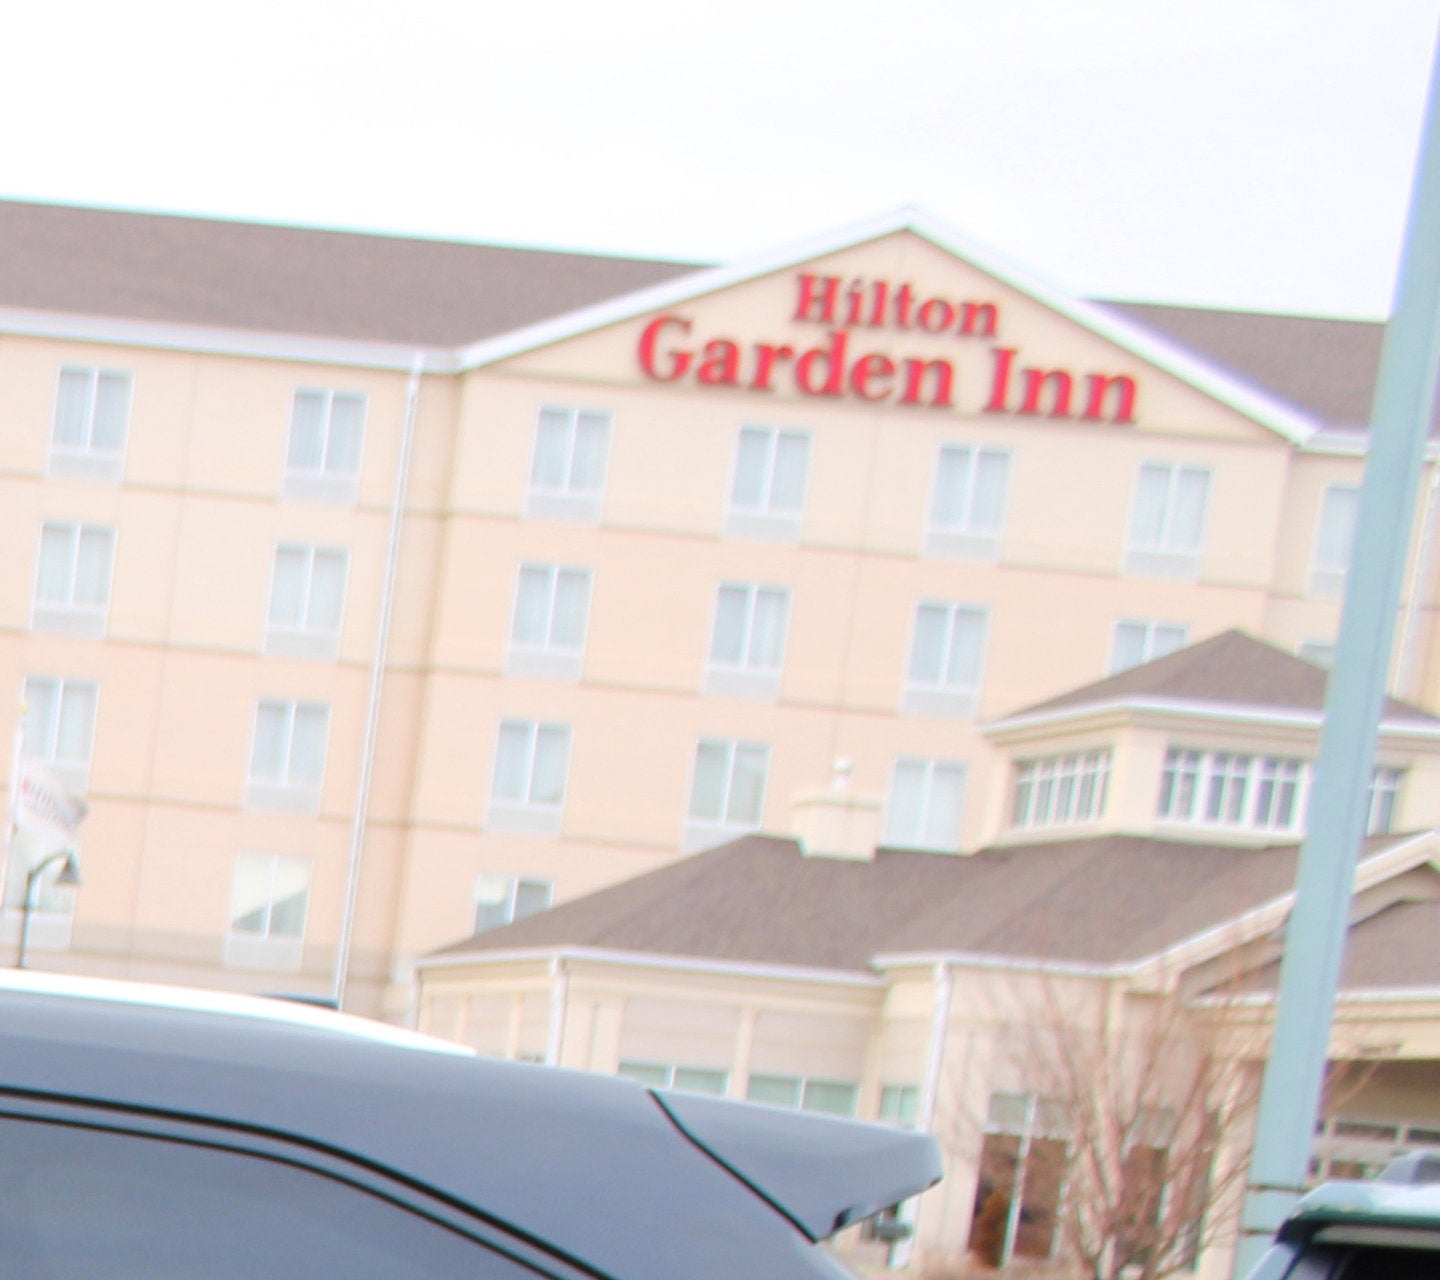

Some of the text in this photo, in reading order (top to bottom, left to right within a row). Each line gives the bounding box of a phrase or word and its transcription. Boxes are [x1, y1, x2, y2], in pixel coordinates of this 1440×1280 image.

[792, 271, 999, 338] Hilton
[636, 313, 1139, 424] Garden Inn
